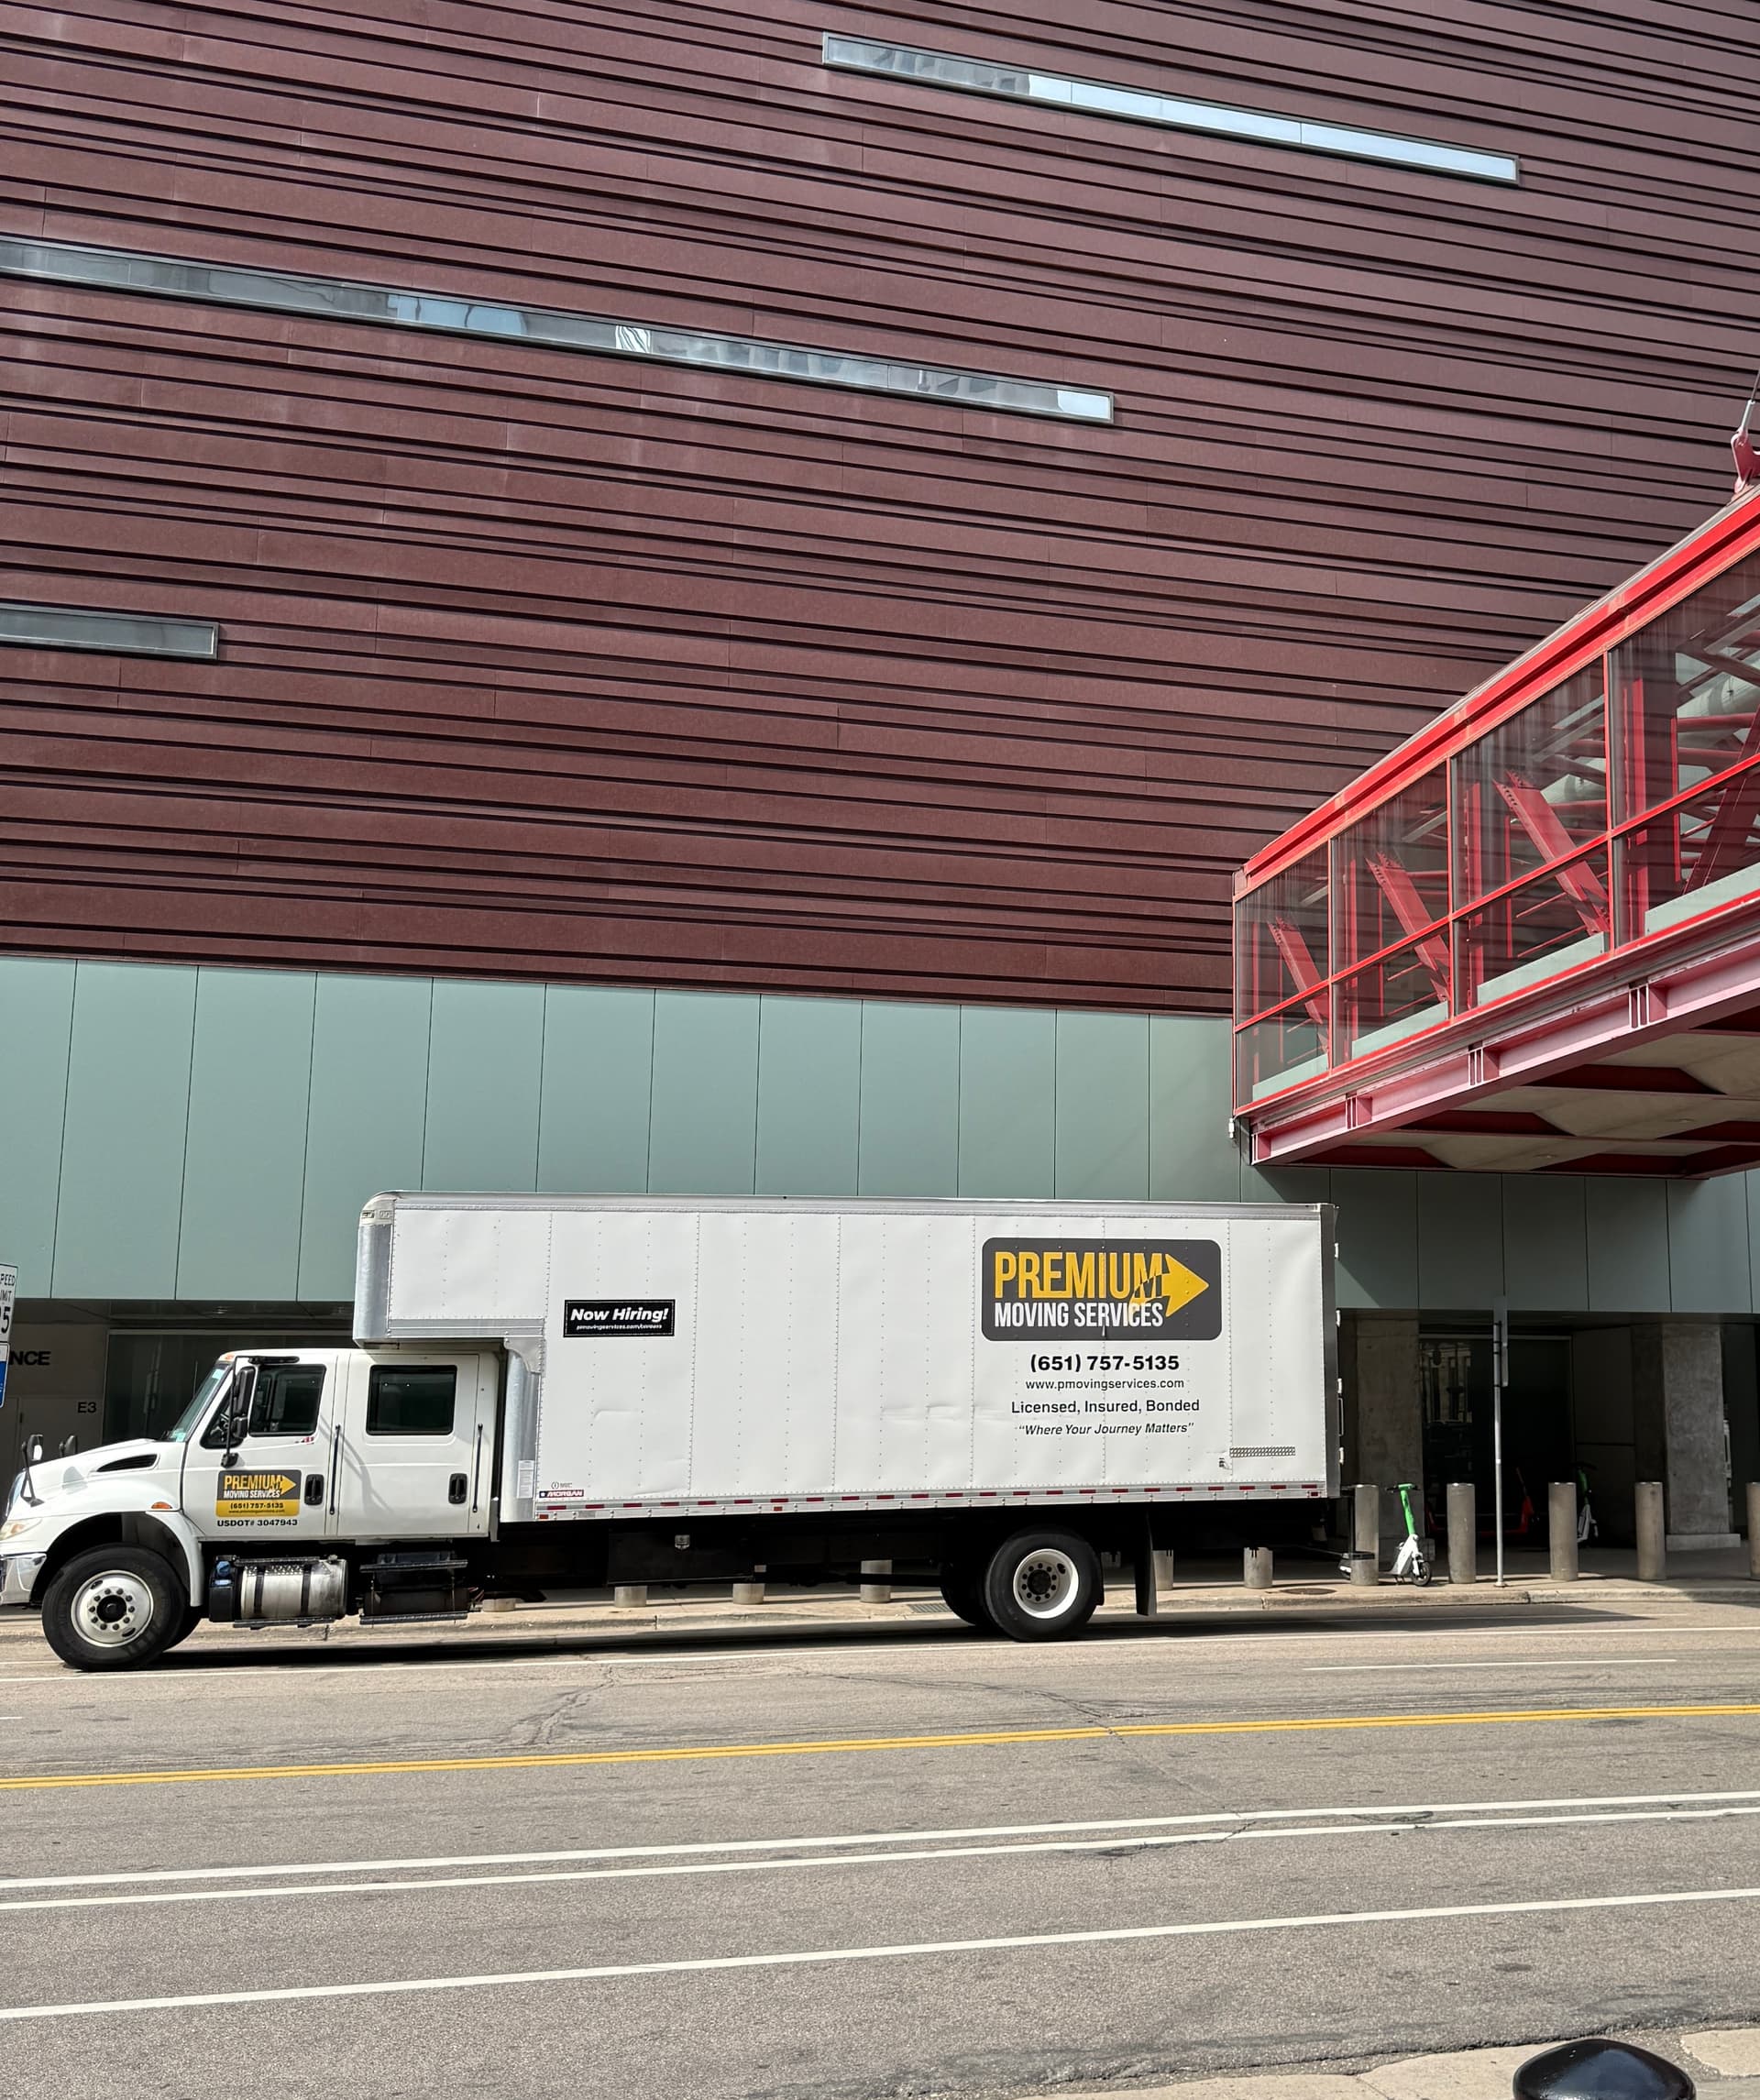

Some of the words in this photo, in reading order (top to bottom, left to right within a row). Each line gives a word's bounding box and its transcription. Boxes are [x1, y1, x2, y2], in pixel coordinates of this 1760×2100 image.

[0, 1273, 15, 1286] PEED
[995, 1251, 1162, 1299] PREMIUM
[0, 1290, 12, 1303] IMIT
[0, 1306, 11, 1333] 5
[570, 1308, 610, 1321] Now
[612, 1306, 669, 1323] Hiring!
[995, 1303, 1069, 1327] MOVING
[1073, 1302, 1163, 1327] SERVICES
[1029, 1354, 1082, 1372] (651)
[1086, 1355, 1180, 1371] 757-5135
[1025, 1378, 1185, 1391] www.pmovingservices.com
[77, 1402, 97, 1413] E3
[1011, 1401, 1082, 1415] Licensed,
[1084, 1400, 1143, 1414] Insured,
[1146, 1399, 1201, 1413] Bonded
[1065, 1424, 1092, 1435] Your
[1094, 1424, 1142, 1436] Journey
[225, 1475, 281, 1490] PREMIUM
[223, 1490, 248, 1499] MOVING
[249, 1490, 280, 1498] SERVICES
[217, 1519, 255, 1527] USDOT#
